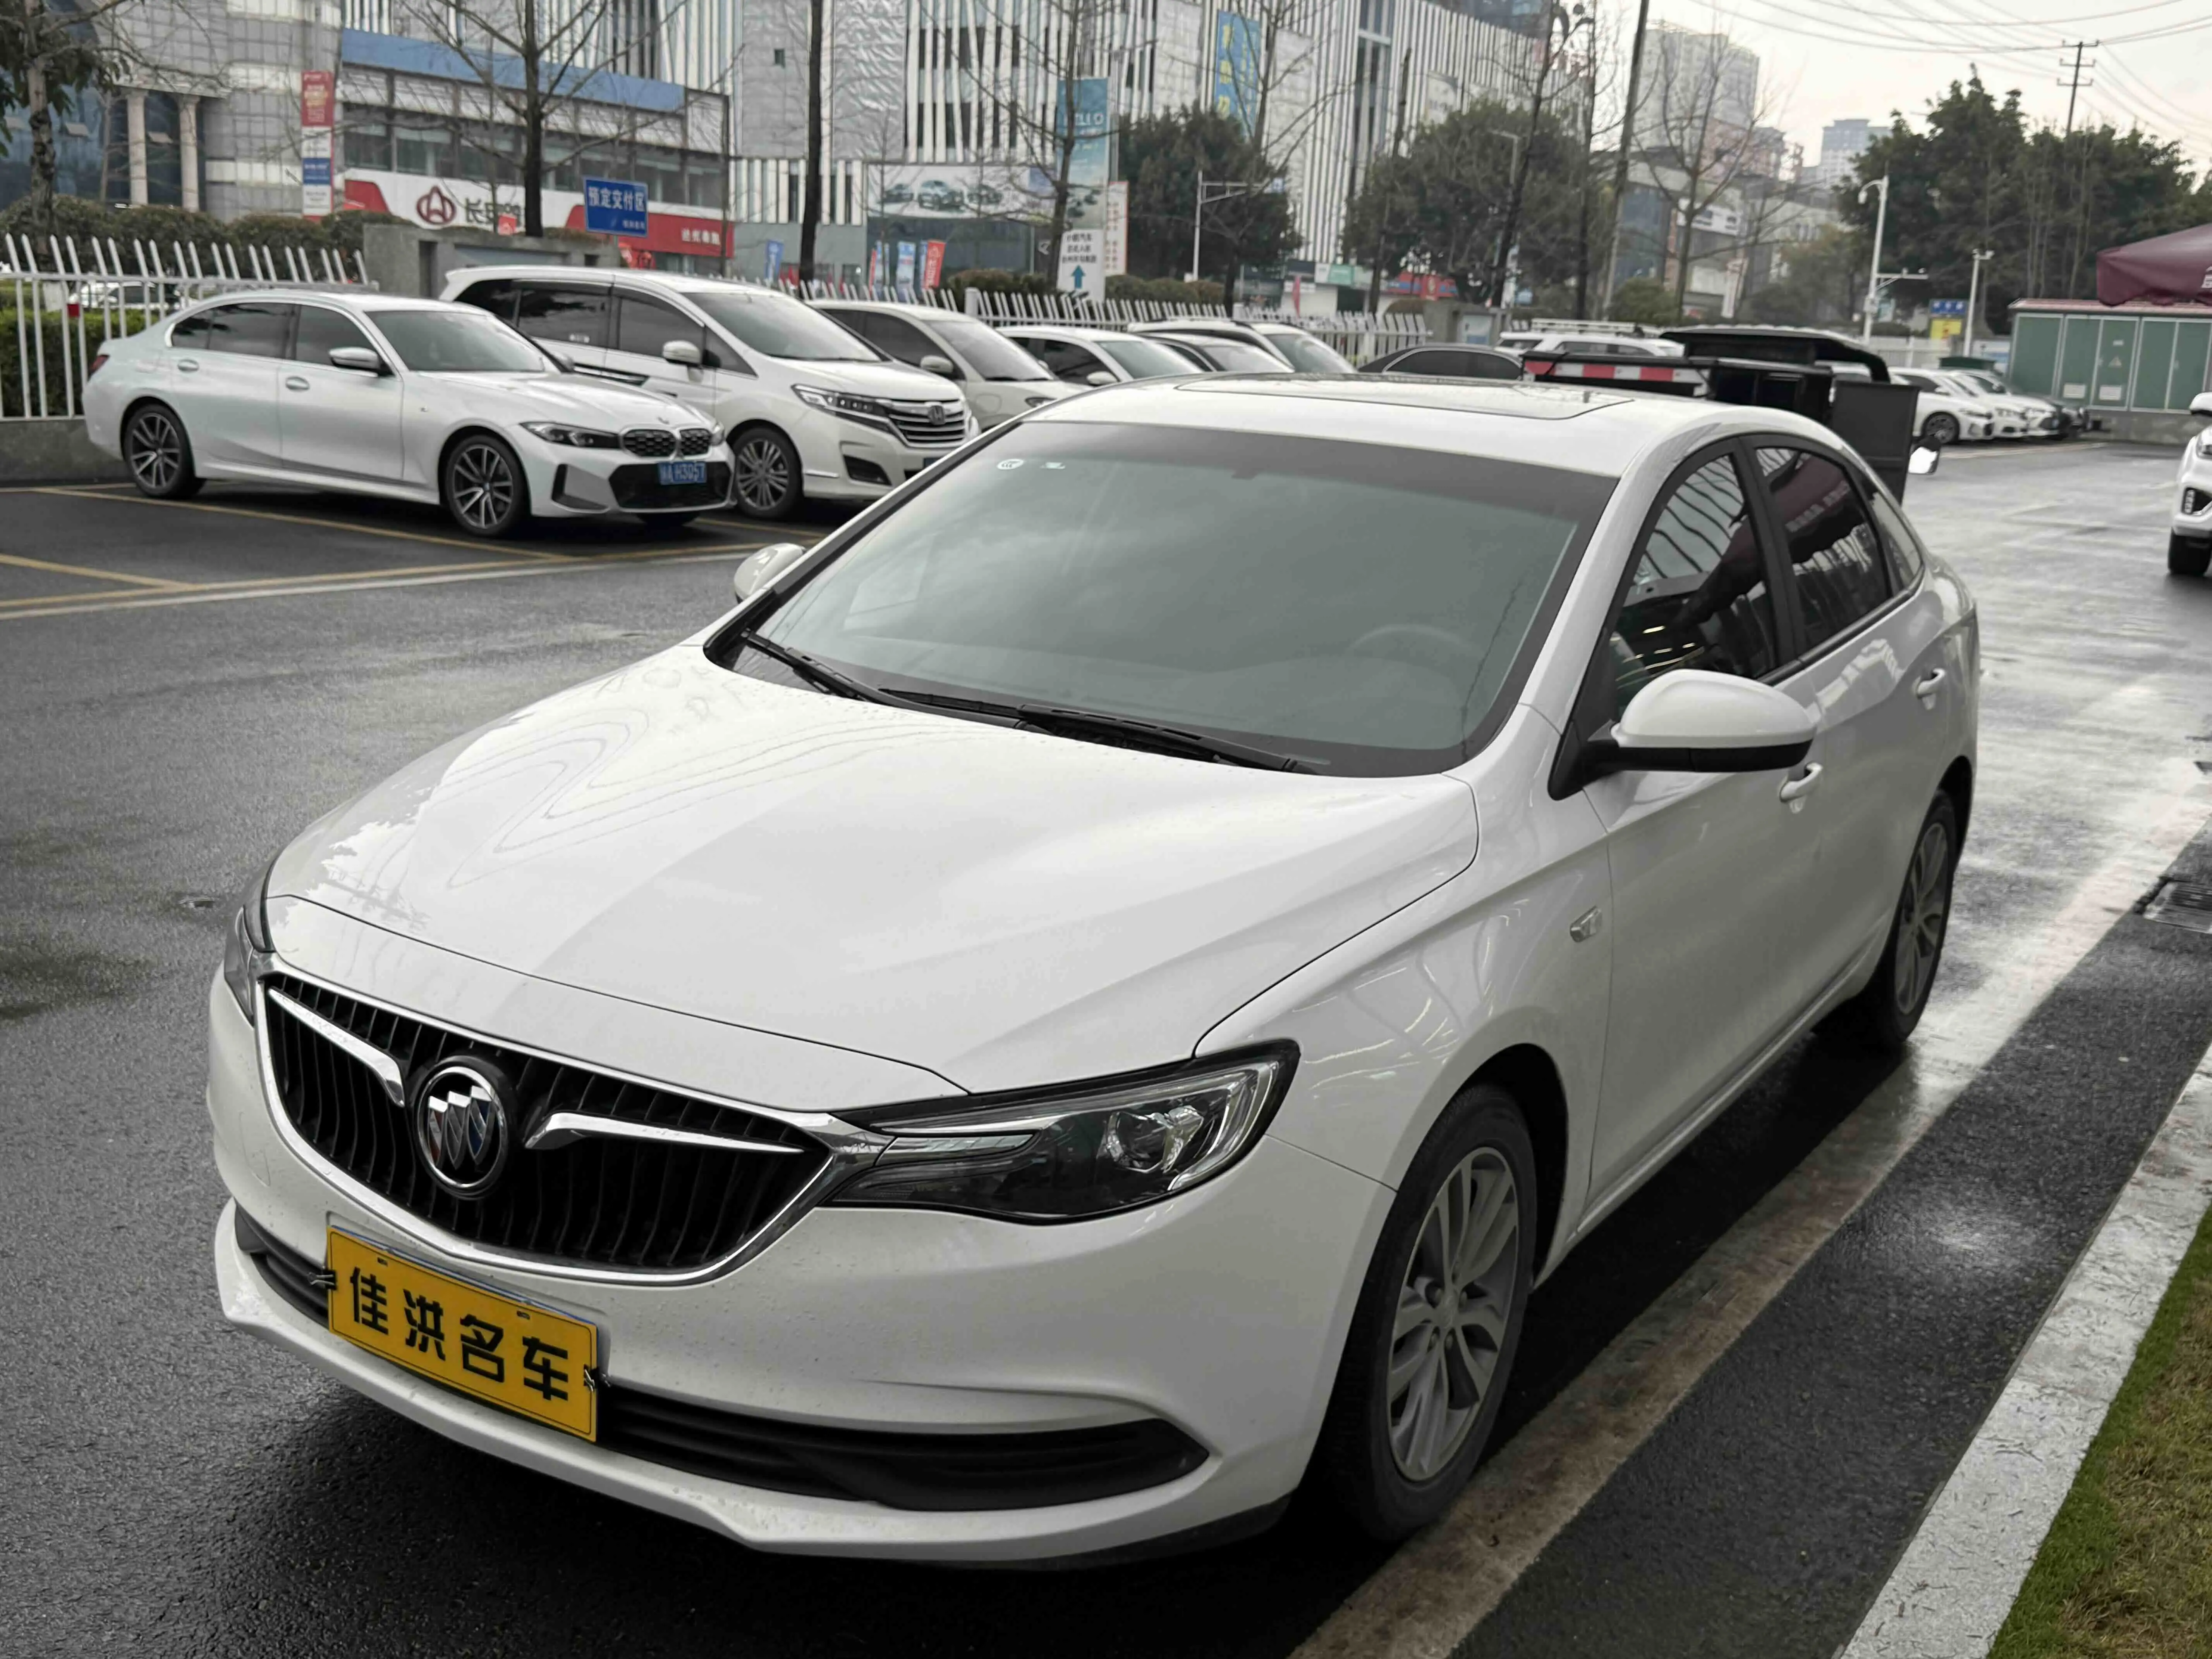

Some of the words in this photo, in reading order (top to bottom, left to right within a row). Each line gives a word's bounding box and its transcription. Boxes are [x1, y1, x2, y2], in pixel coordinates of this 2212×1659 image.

[588, 186, 645, 211] 预定交付区
[350, 1267, 568, 1401] 佳洪名车
